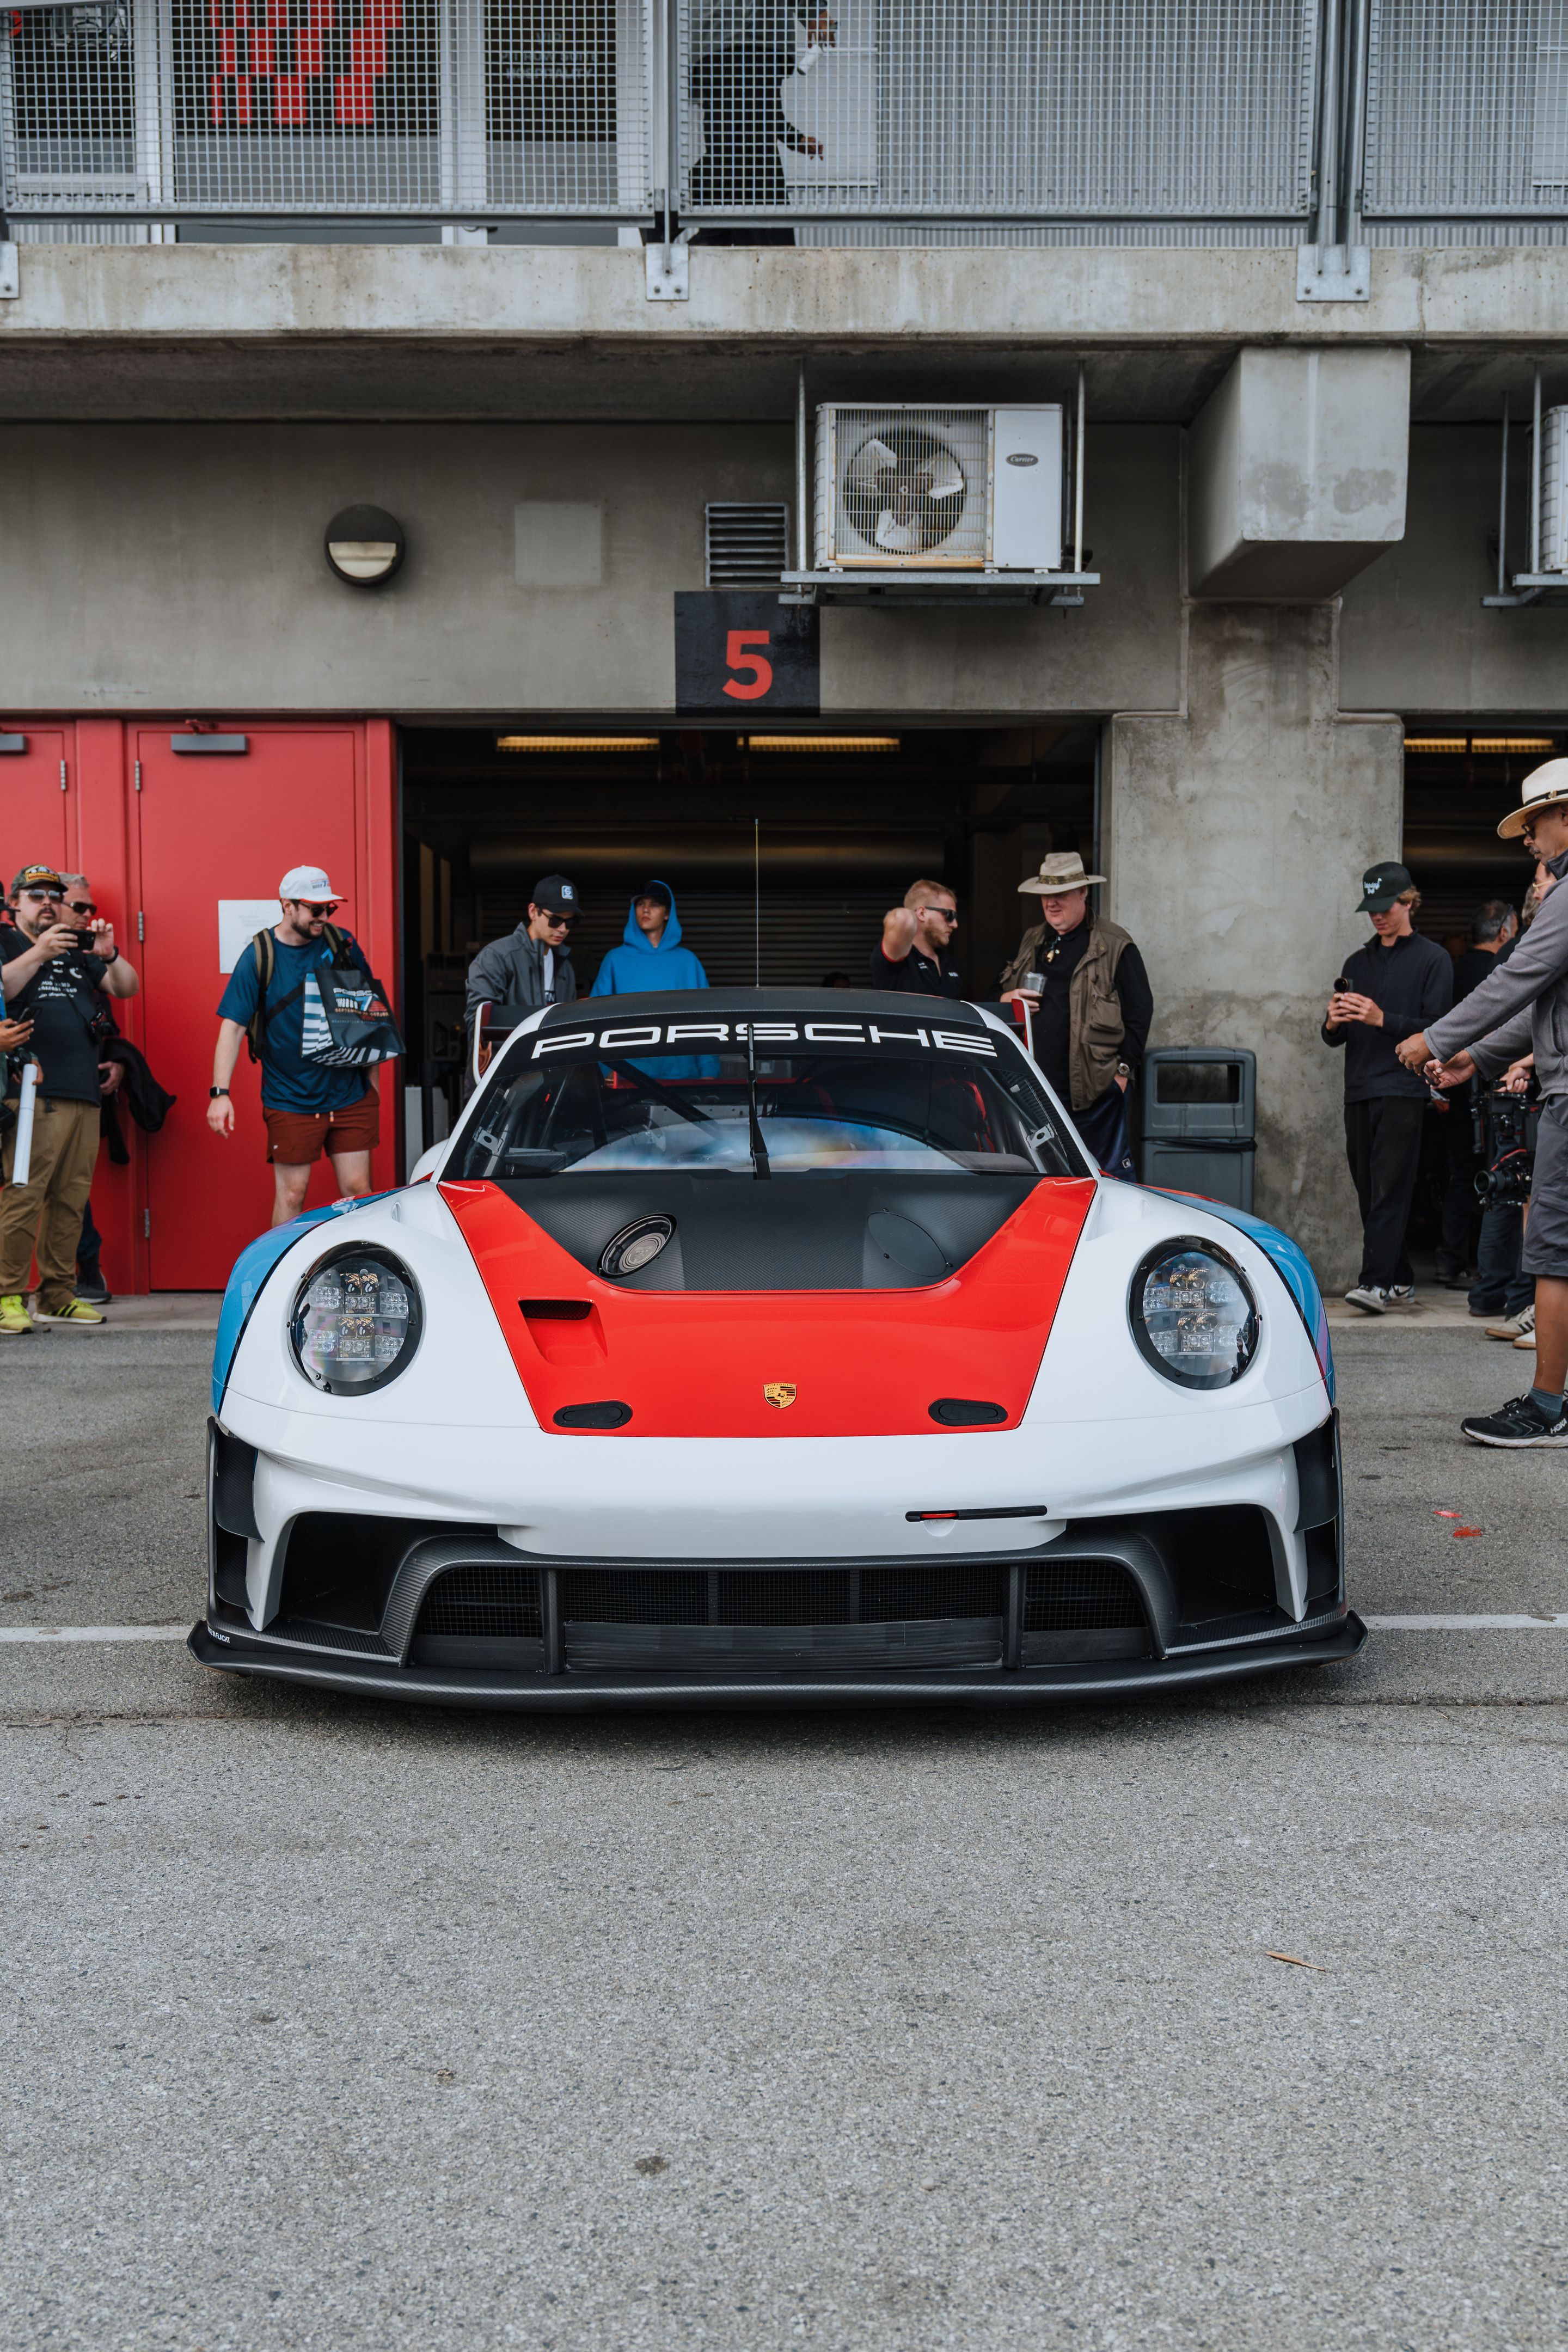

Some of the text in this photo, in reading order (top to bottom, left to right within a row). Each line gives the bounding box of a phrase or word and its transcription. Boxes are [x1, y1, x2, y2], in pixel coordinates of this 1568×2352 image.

[722, 630, 773, 700] 5
[531, 1022, 998, 1059] PORSCHE
[1550, 1418, 1567, 1435] HOKA
[216, 1632, 230, 1644] FLACHT
